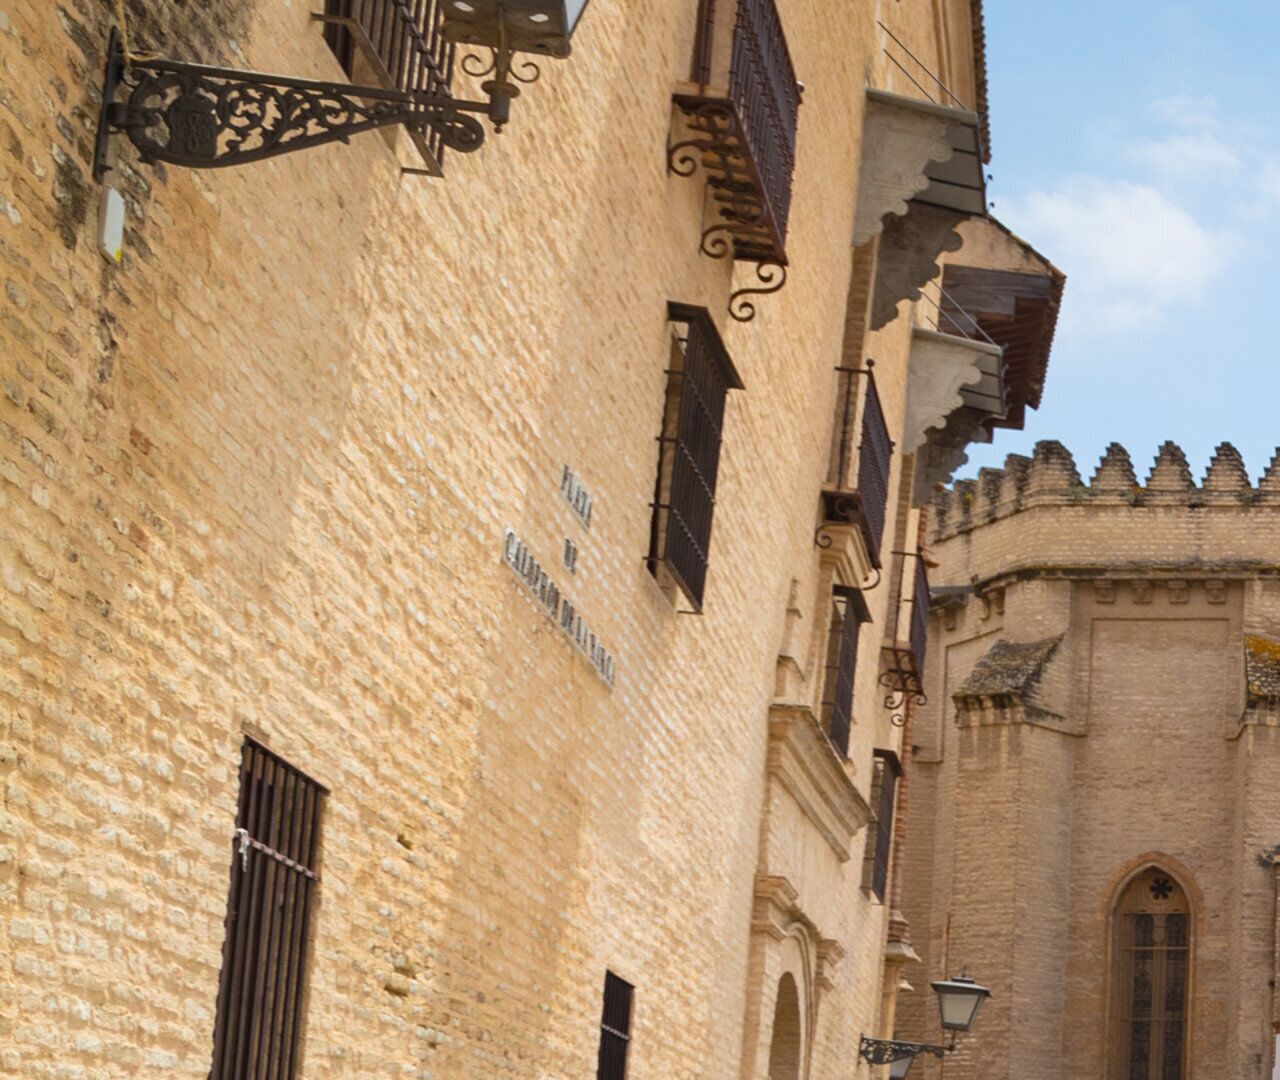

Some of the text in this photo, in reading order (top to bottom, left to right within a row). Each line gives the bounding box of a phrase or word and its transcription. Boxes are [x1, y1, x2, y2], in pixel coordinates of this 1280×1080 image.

[561, 464, 592, 529] PLAZA
[564, 538, 578, 575] DE
[560, 599, 575, 636] DE
[575, 615, 588, 653] LA
